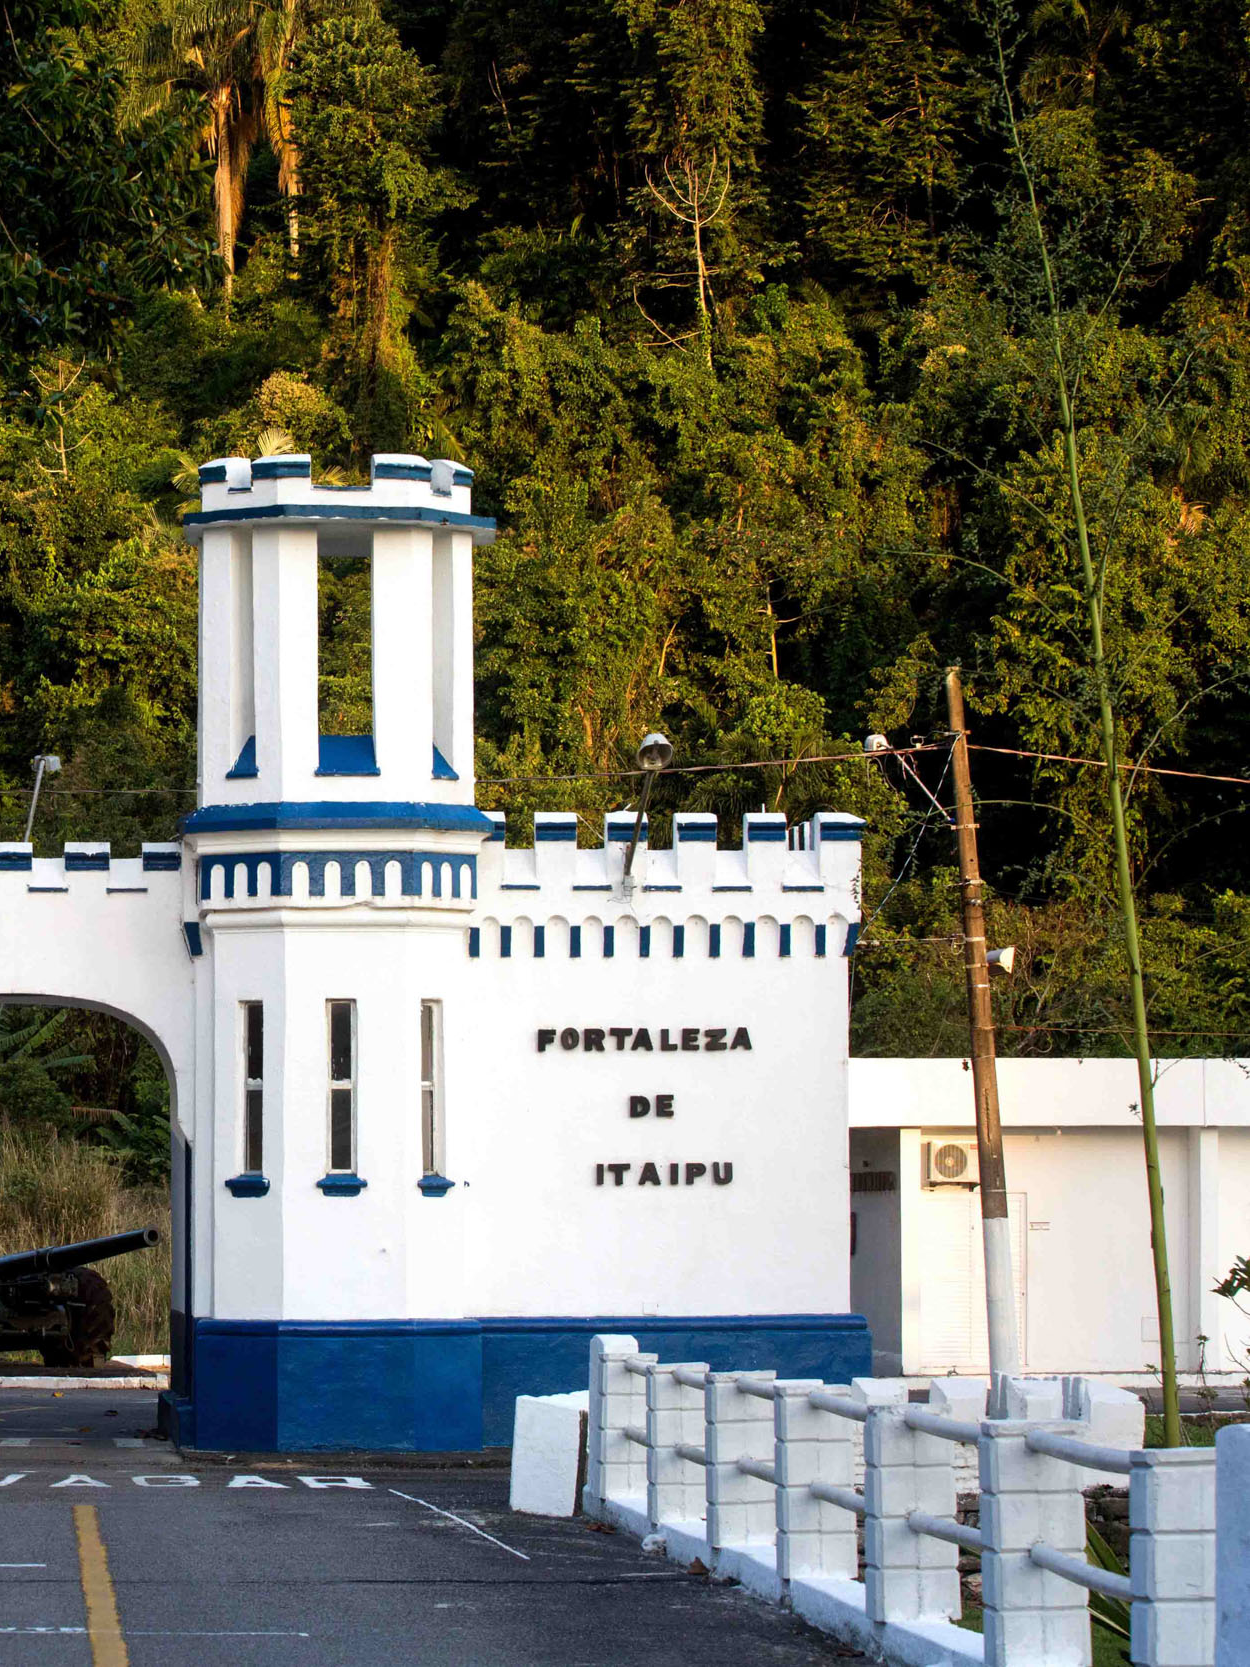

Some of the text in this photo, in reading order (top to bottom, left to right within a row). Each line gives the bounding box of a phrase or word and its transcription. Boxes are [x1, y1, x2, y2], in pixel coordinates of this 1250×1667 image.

[537, 1027, 753, 1053] FORTALEZA
[629, 1094, 675, 1119] DE
[596, 1161, 733, 1187] ITAIPU
